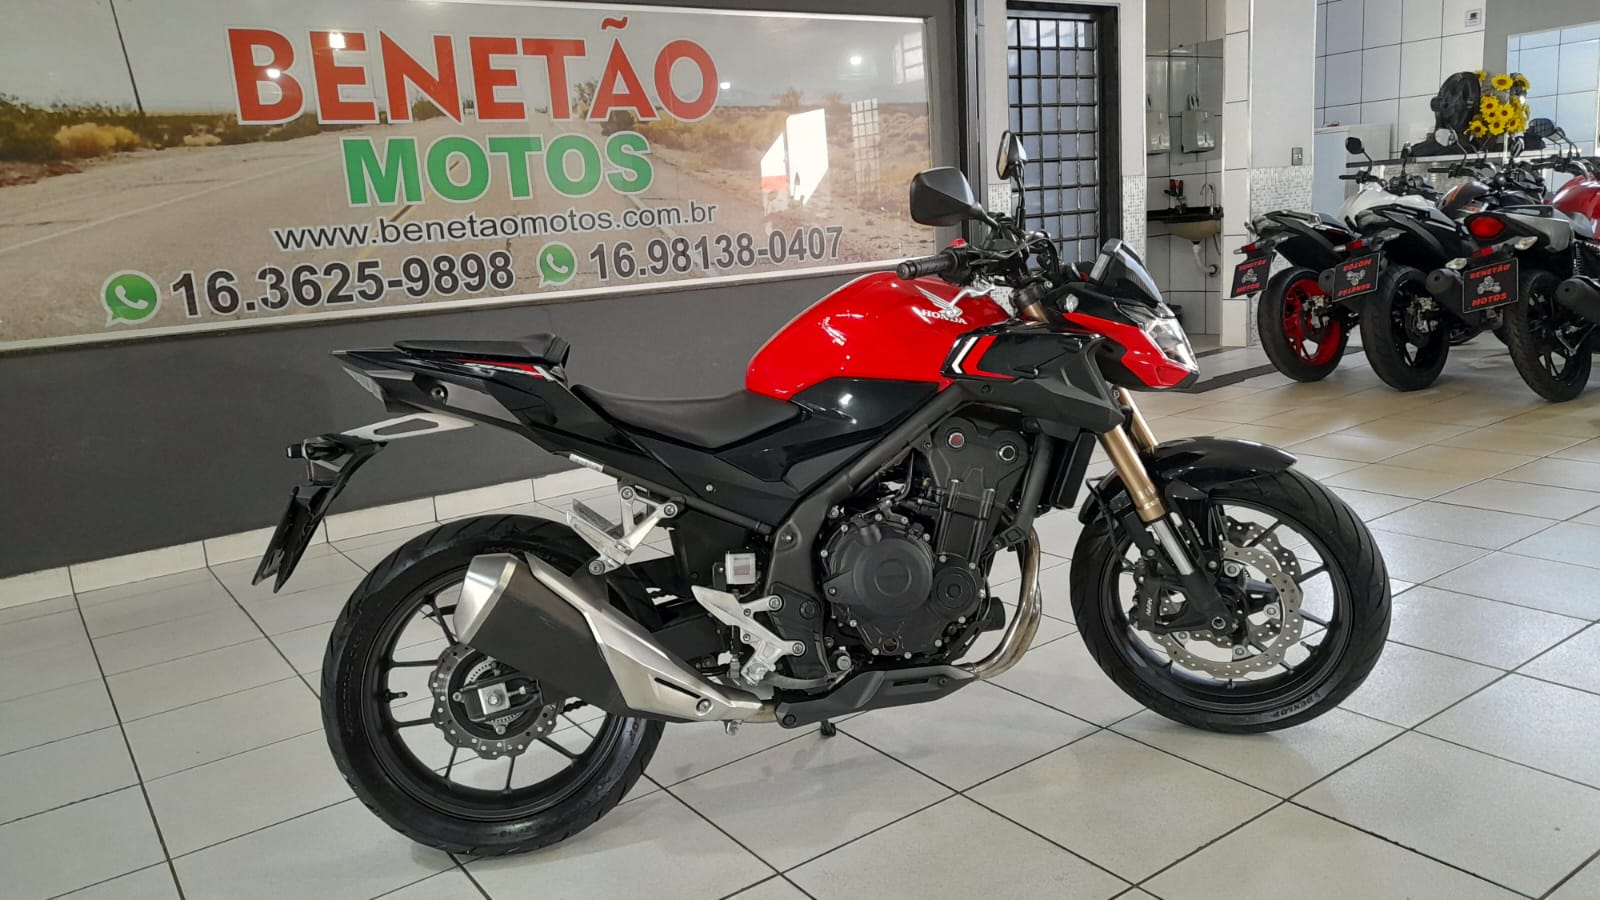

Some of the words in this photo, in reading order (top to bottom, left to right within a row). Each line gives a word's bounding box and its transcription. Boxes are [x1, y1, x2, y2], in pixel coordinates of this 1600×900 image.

[227, 16, 719, 122] BENETÃO
[340, 133, 653, 203] MOTOS
[274, 201, 717, 249] www.benetaomotos.com.br
[172, 251, 515, 316] 16.3625-9898
[590, 226, 843, 280] 16.98138-0407
[920, 308, 969, 325] HONDA
[1471, 292, 1508, 307] MOTOS
[1271, 695, 1314, 718] DUNLOP
